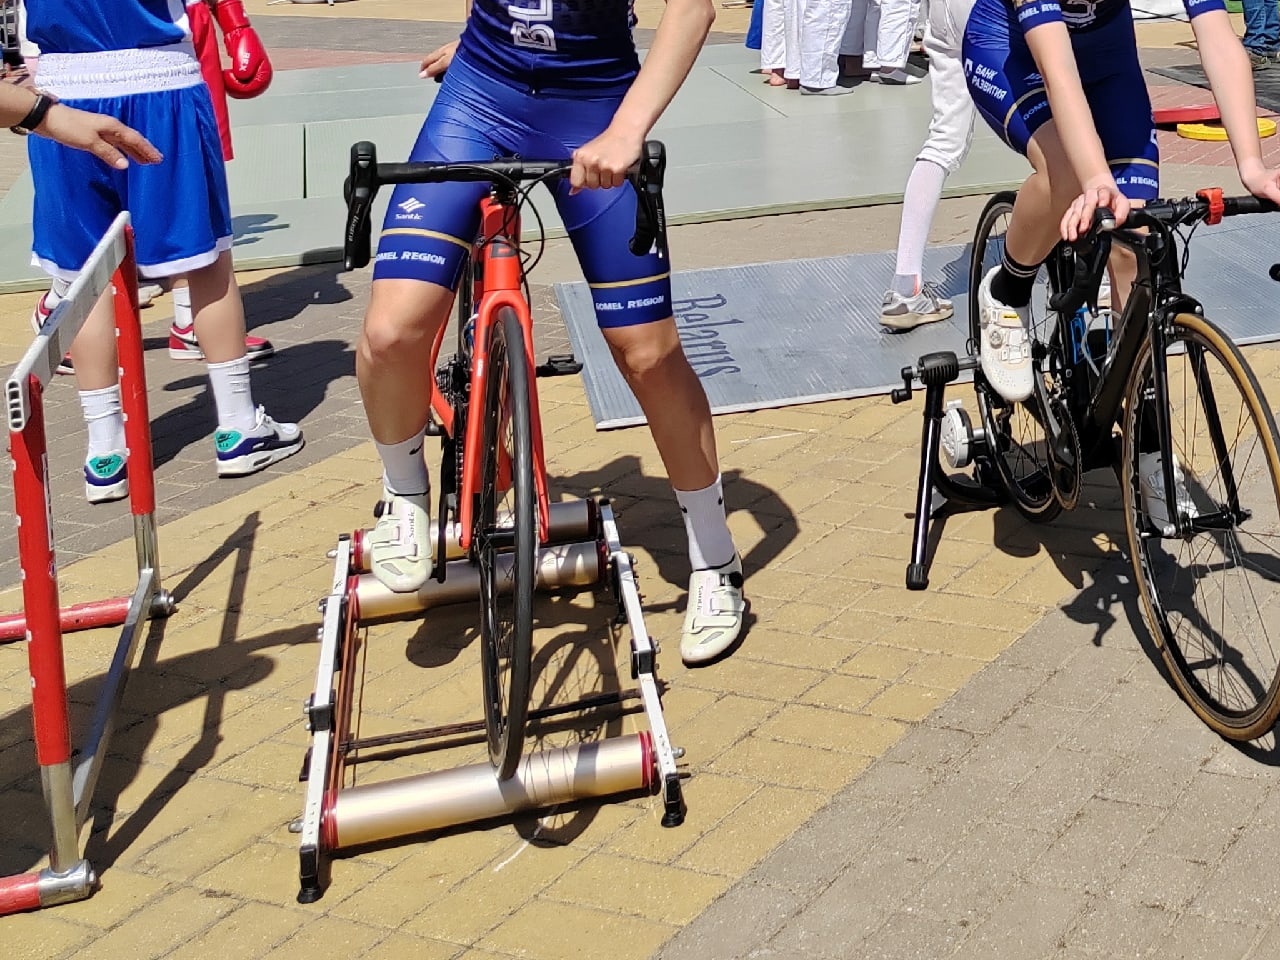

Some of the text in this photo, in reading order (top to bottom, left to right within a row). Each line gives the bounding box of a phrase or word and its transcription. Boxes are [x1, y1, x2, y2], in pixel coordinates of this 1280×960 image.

[974, 63, 998, 82] БАНК
[971, 75, 1009, 102] РАЗВИТИЯ
[395, 213, 423, 221] Santic
[401, 250, 447, 265] REGION
[627, 295, 665, 309] REGION
